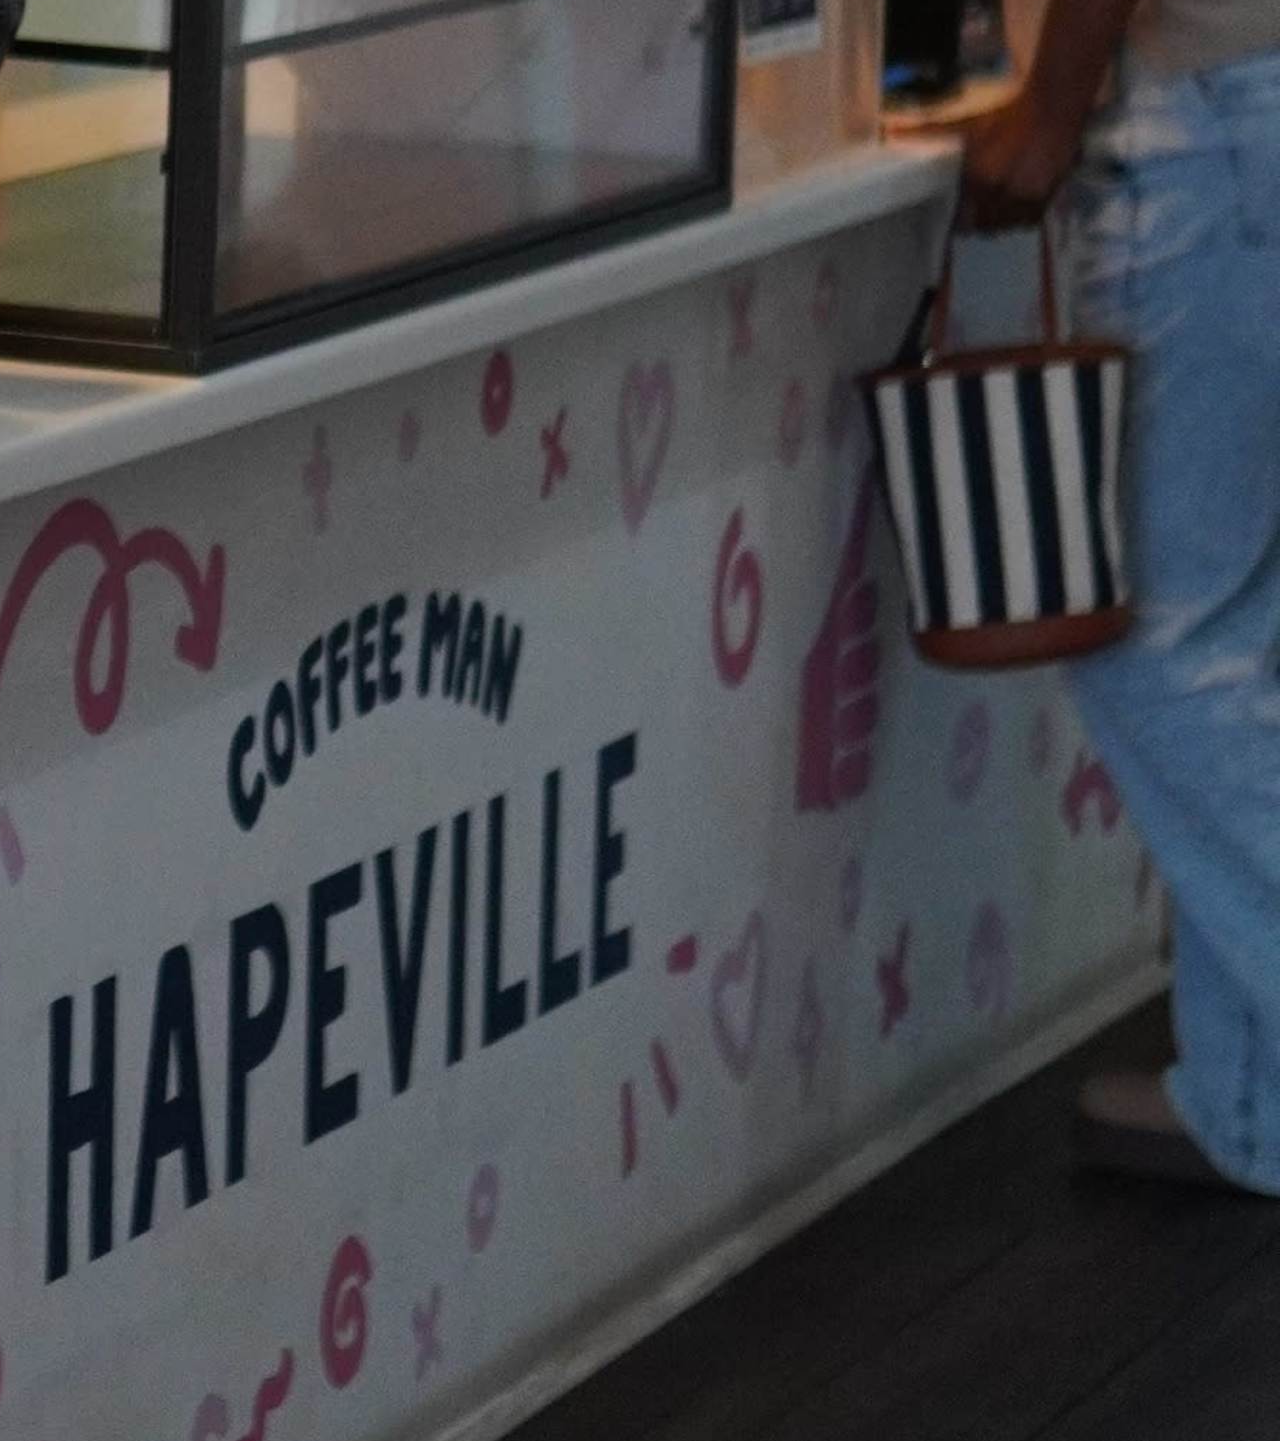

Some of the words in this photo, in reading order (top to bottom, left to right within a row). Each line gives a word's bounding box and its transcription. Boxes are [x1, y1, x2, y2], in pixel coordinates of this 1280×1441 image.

[227, 592, 409, 832] COFFEE
[416, 589, 524, 725] MAN
[44, 730, 638, 1286] HAPEVILLE
